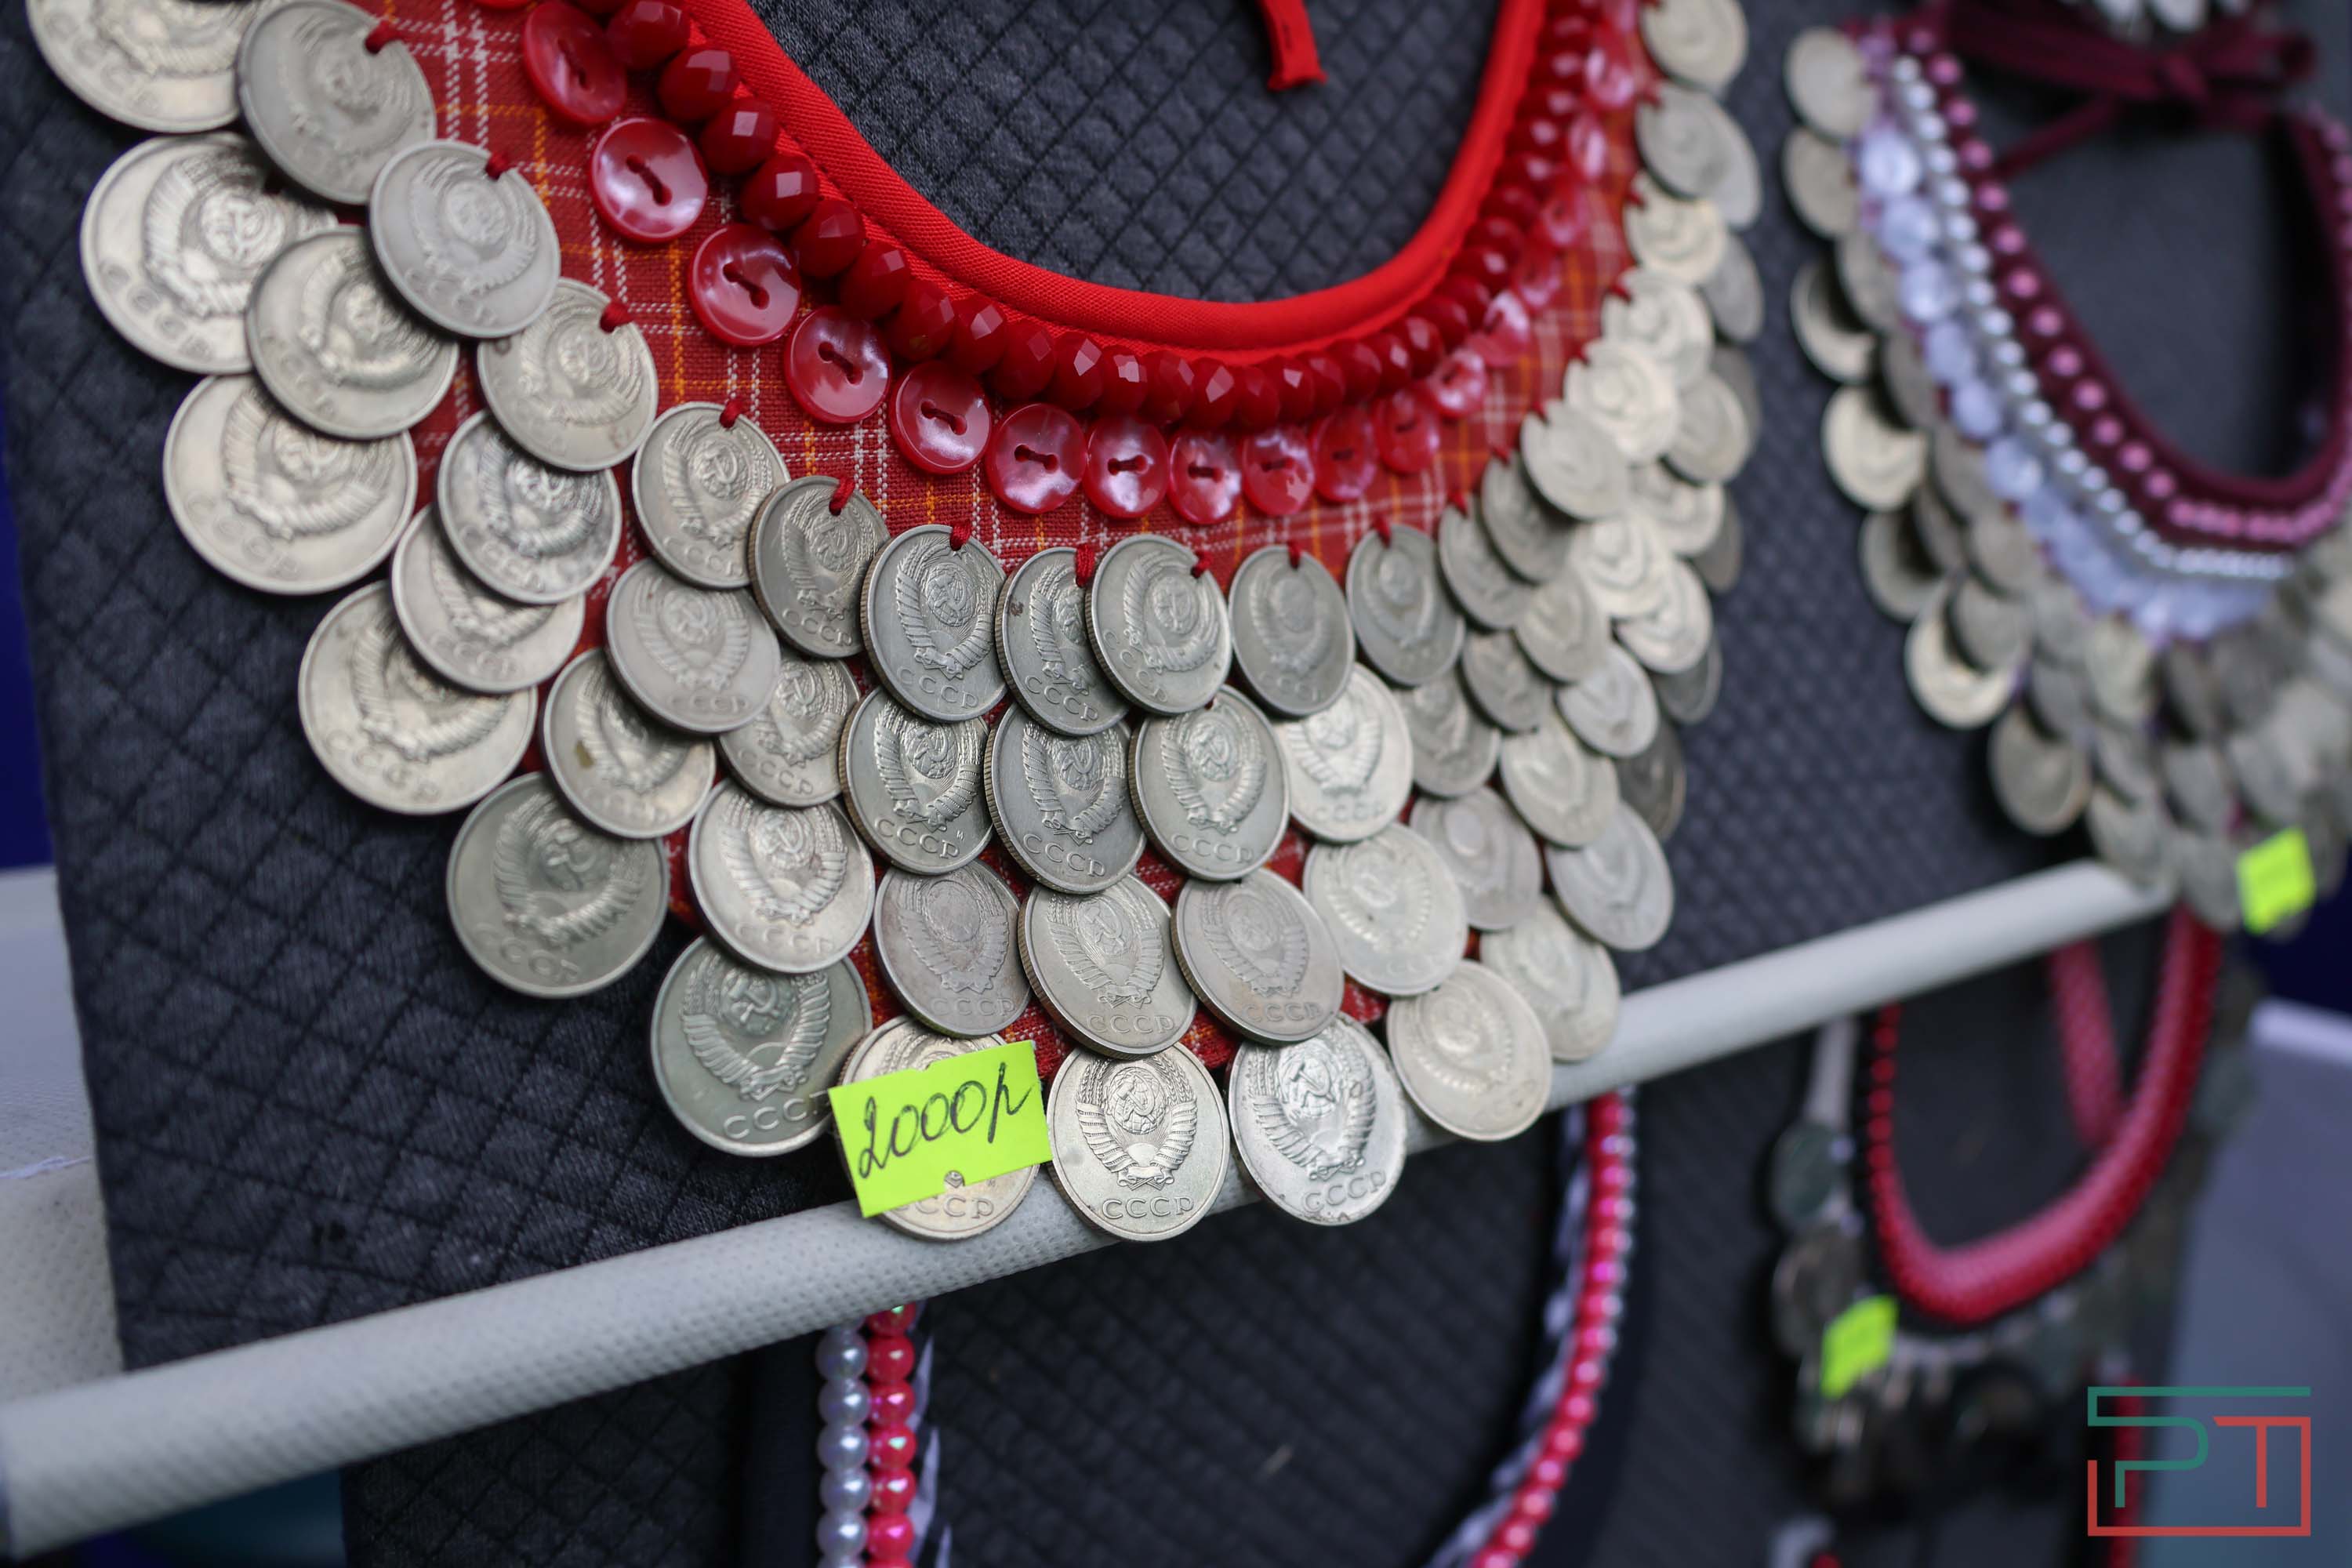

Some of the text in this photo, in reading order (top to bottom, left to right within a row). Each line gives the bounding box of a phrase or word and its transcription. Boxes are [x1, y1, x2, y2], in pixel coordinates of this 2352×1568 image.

[782, 608, 852, 644] СССР
[1104, 629, 1167, 703] СССР
[897, 667, 979, 707] СССР
[1024, 675, 1098, 721] СССР
[877, 816, 960, 859] СССР
[1023, 833, 1106, 878] СССР
[1171, 833, 1252, 862] СССР
[930, 997, 1017, 1017] СССР
[1087, 1013, 1176, 1034] СССР
[1243, 1002, 1323, 1022] СССР
[1102, 1194, 1196, 1221] СССР
[1301, 1171, 1386, 1209] СССР
